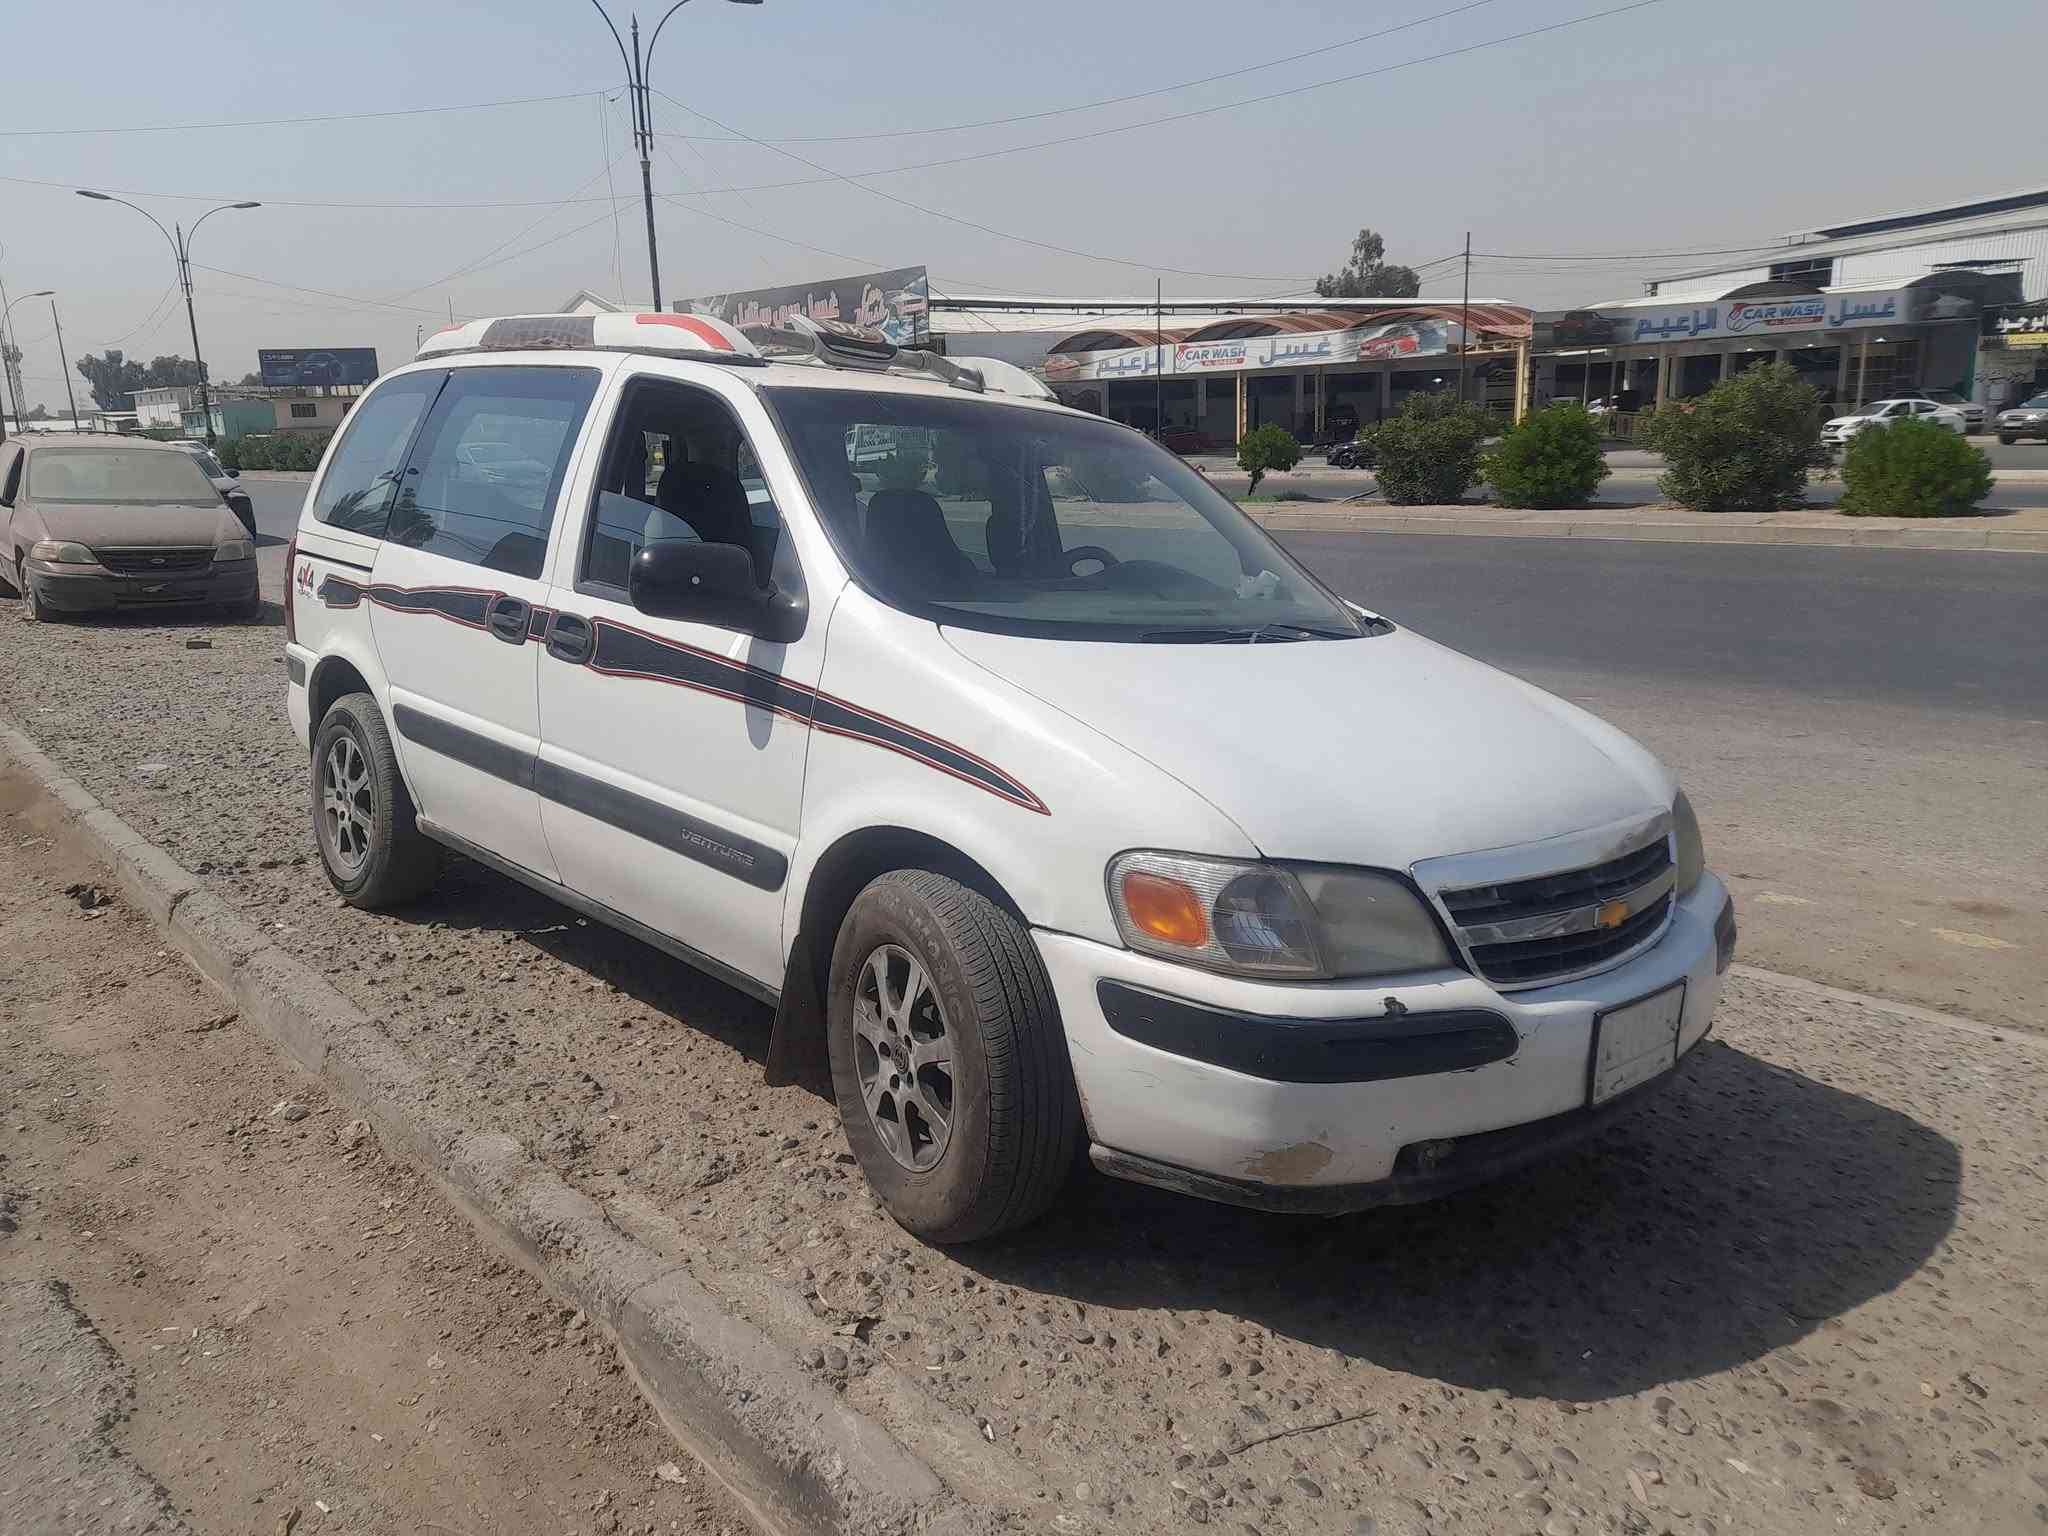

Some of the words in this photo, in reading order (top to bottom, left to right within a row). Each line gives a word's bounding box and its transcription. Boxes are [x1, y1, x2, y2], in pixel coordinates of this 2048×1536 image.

[1633, 306, 1718, 341] الزعيم
[1743, 307, 1778, 320] CAR
[1779, 303, 1825, 318] WASH
[1829, 296, 1896, 327] غسل
[1096, 347, 1166, 378] الزعيم
[1185, 349, 1209, 361] CAR
[1212, 345, 1248, 359] WASH
[1259, 337, 1331, 366] غسل
